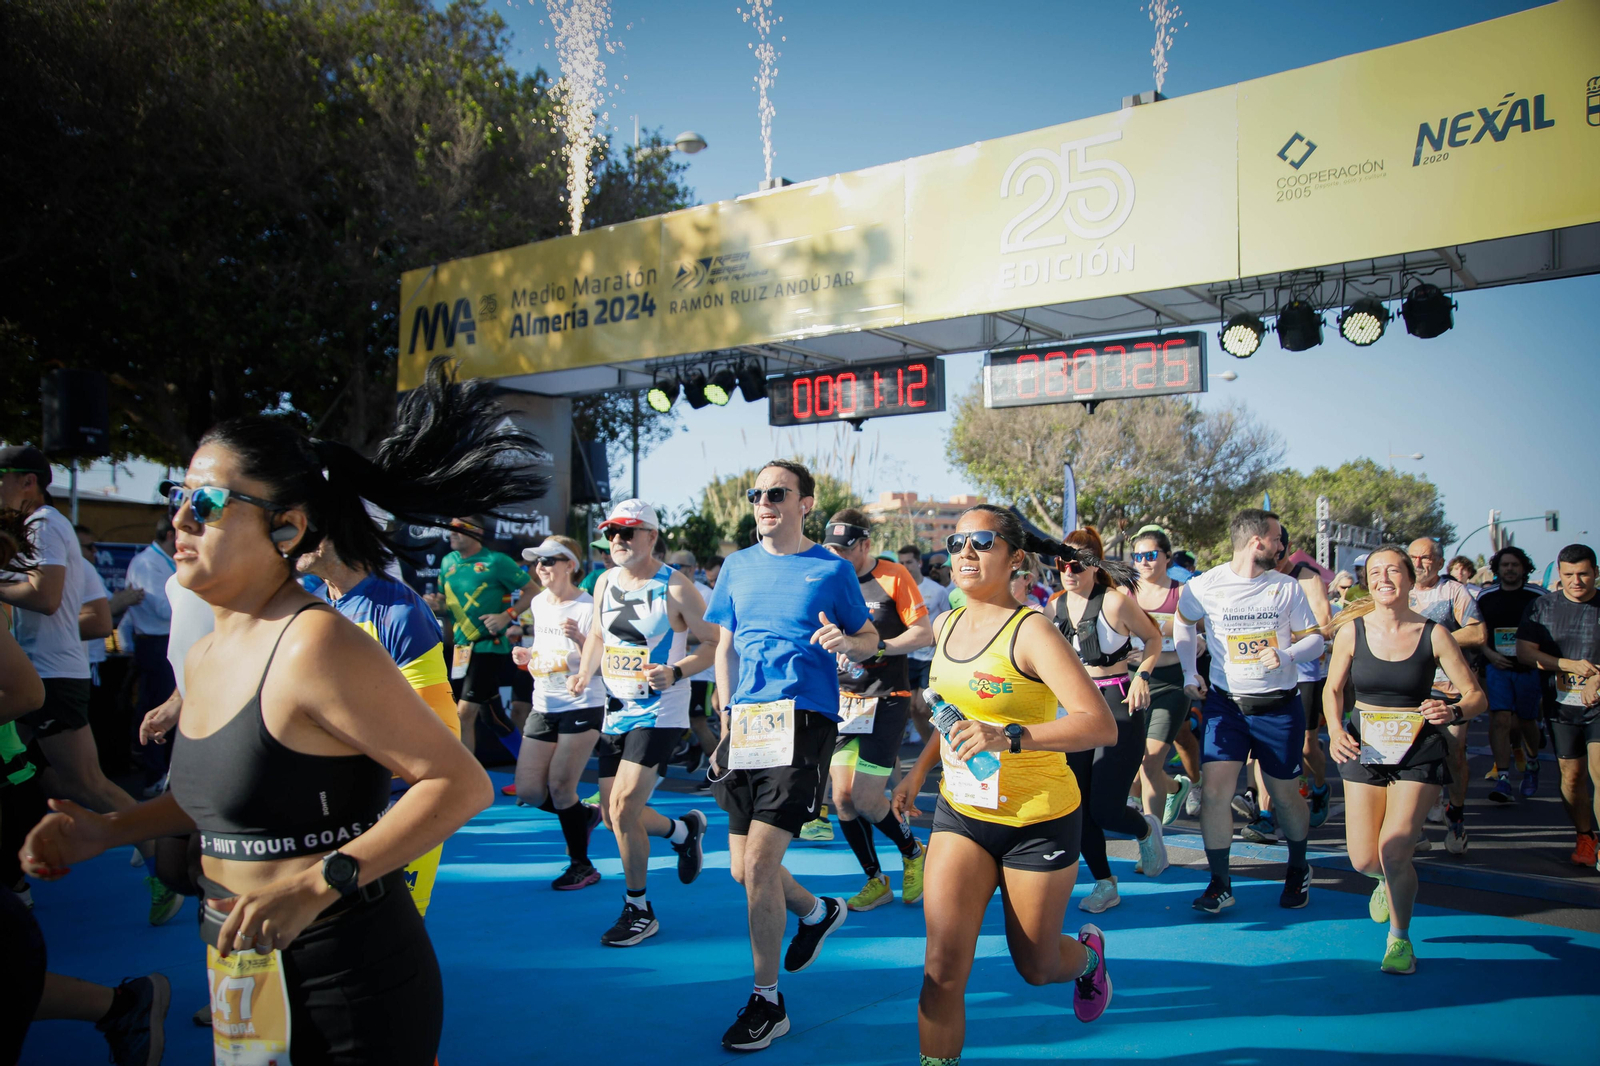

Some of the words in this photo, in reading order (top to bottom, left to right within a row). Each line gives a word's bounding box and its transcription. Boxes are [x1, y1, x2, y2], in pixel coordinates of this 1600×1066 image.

[1422, 151, 1449, 166] 2020
[1276, 158, 1384, 189] COOPERACIÓN
[1000, 130, 1136, 255] 25
[1276, 186, 1312, 203] 2005
[1000, 242, 1136, 289] EDICIÓN
[510, 283, 566, 309] Medio
[572, 265, 658, 297] Maratón
[669, 290, 724, 314] RAMÓN
[730, 285, 768, 305] RUIZ
[774, 270, 855, 298] ANDÚJAR
[509, 301, 589, 338] Almería
[593, 292, 657, 326] 2024
[1222, 612, 1255, 621] Almería
[1256, 611, 1279, 619] 2024
[606, 655, 643, 672] 1322
[1560, 674, 1588, 686] 142
[739, 712, 785, 735] 1431
[1372, 720, 1413, 737] 992
[241, 837, 297, 856] YOUR
[304, 822, 363, 848] GOAS
